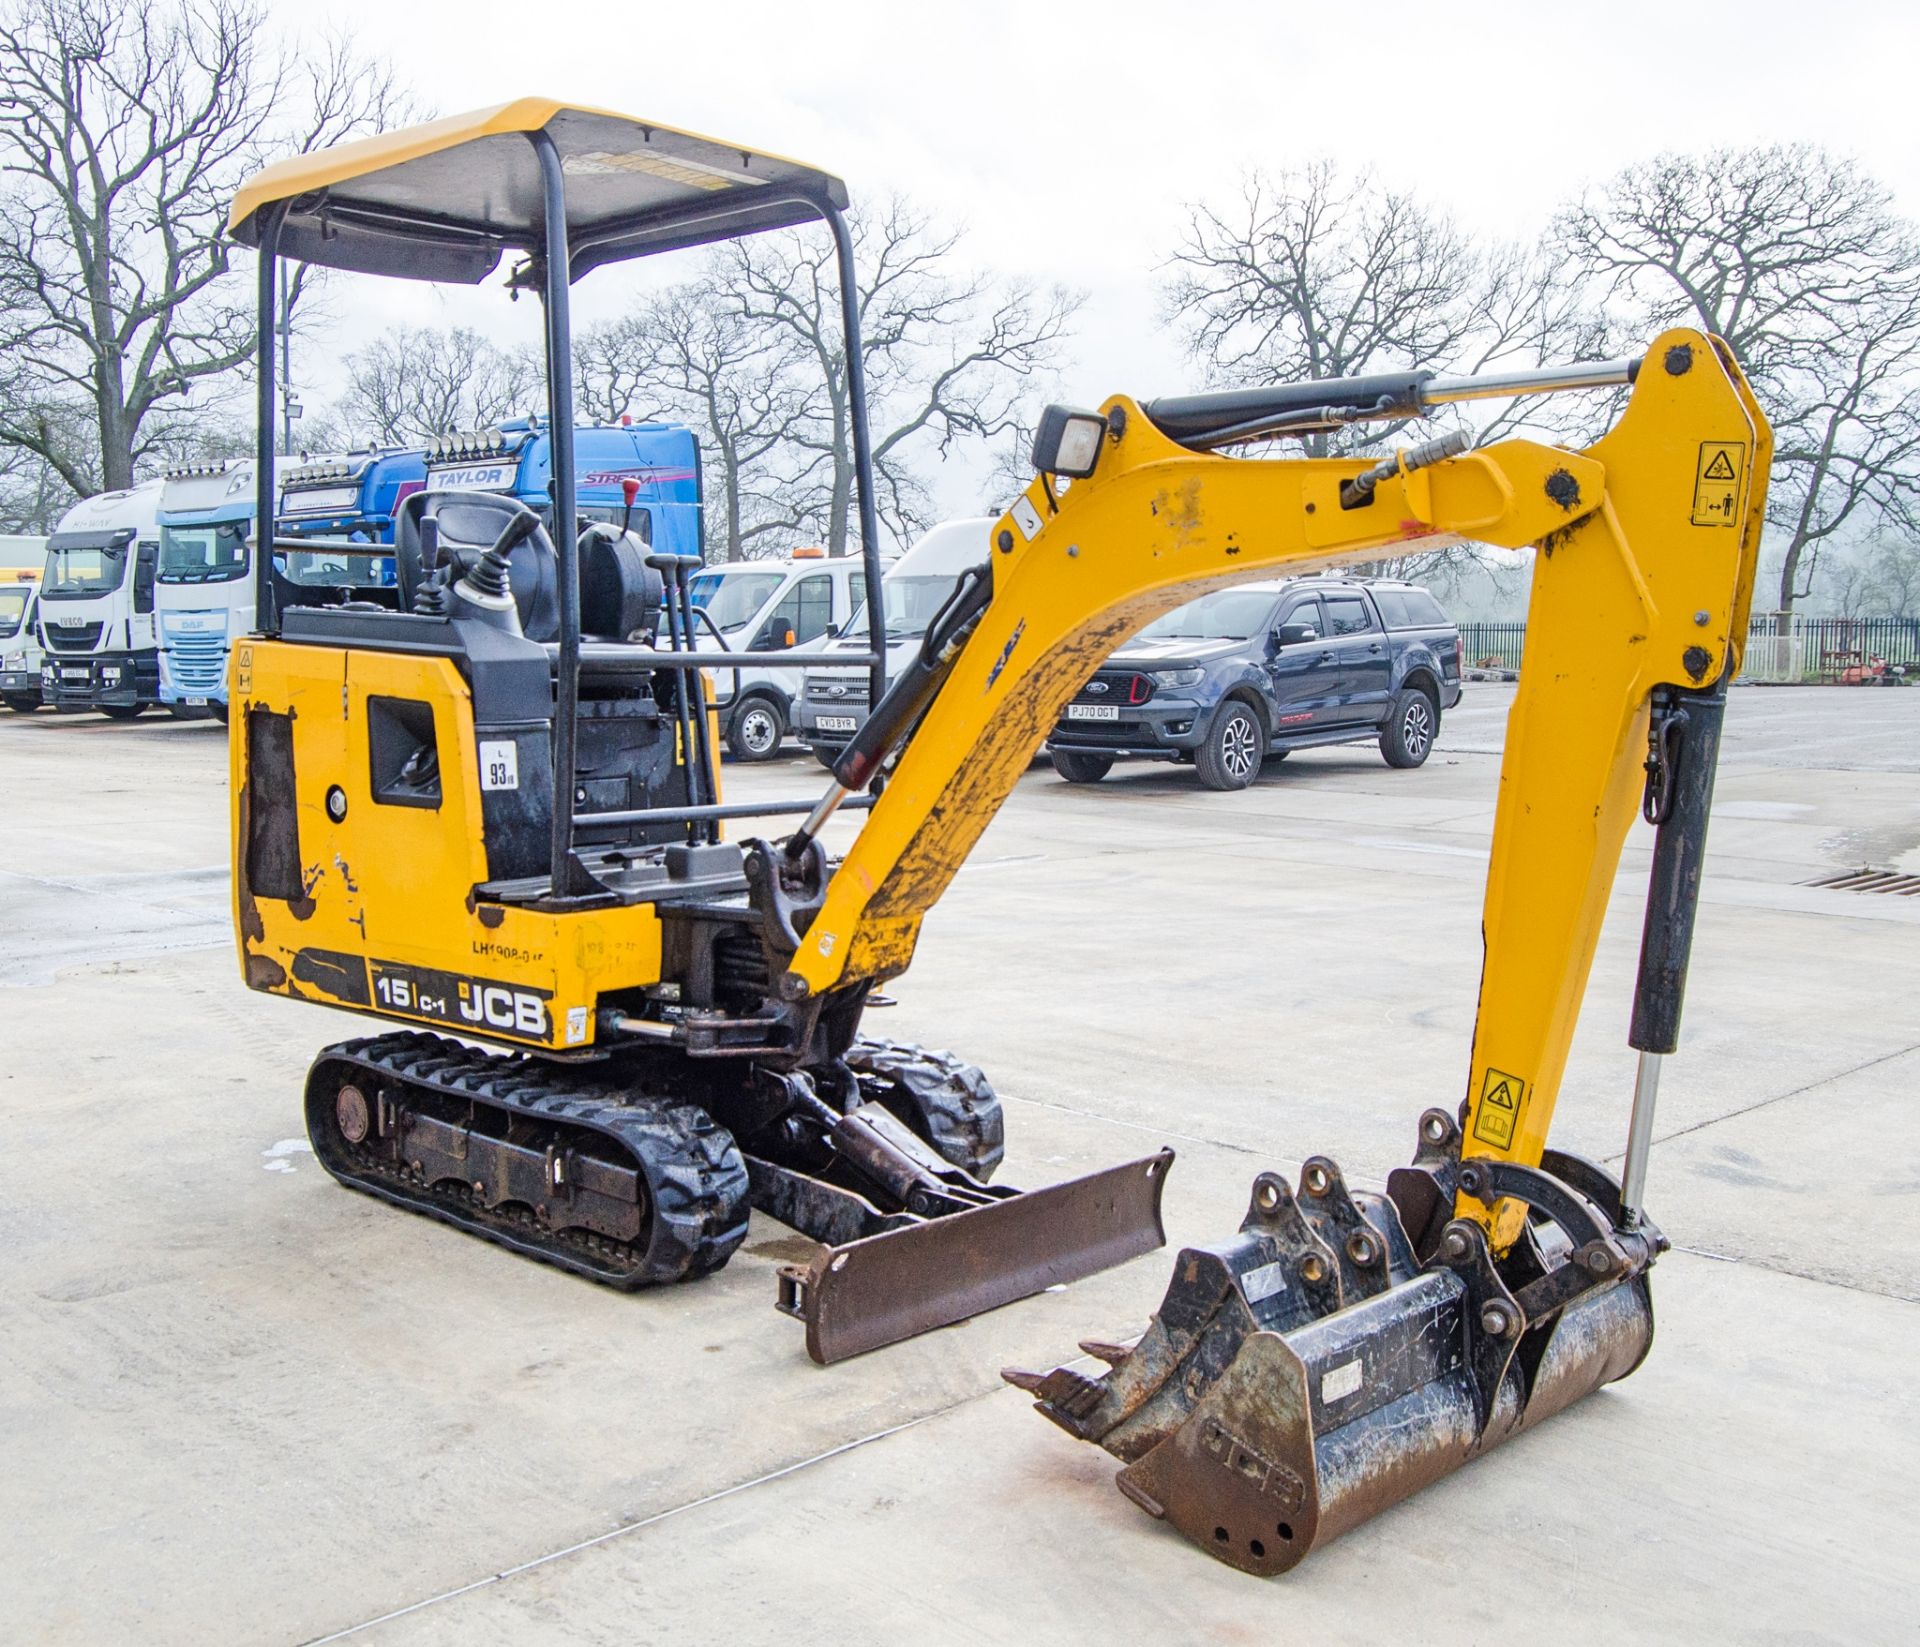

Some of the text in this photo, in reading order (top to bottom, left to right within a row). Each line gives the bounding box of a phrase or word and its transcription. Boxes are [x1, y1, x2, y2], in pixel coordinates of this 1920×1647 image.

[438, 469, 502, 488] TAYLOR
[60, 617, 83, 626] IVECO
[181, 621, 204, 629] DAF
[1072, 706, 1096, 717] PJ70
[820, 718, 852, 729] CV13 BYR
[491, 763, 506, 785] 93
[377, 976, 411, 1007] 15
[458, 982, 547, 1035] JCB
